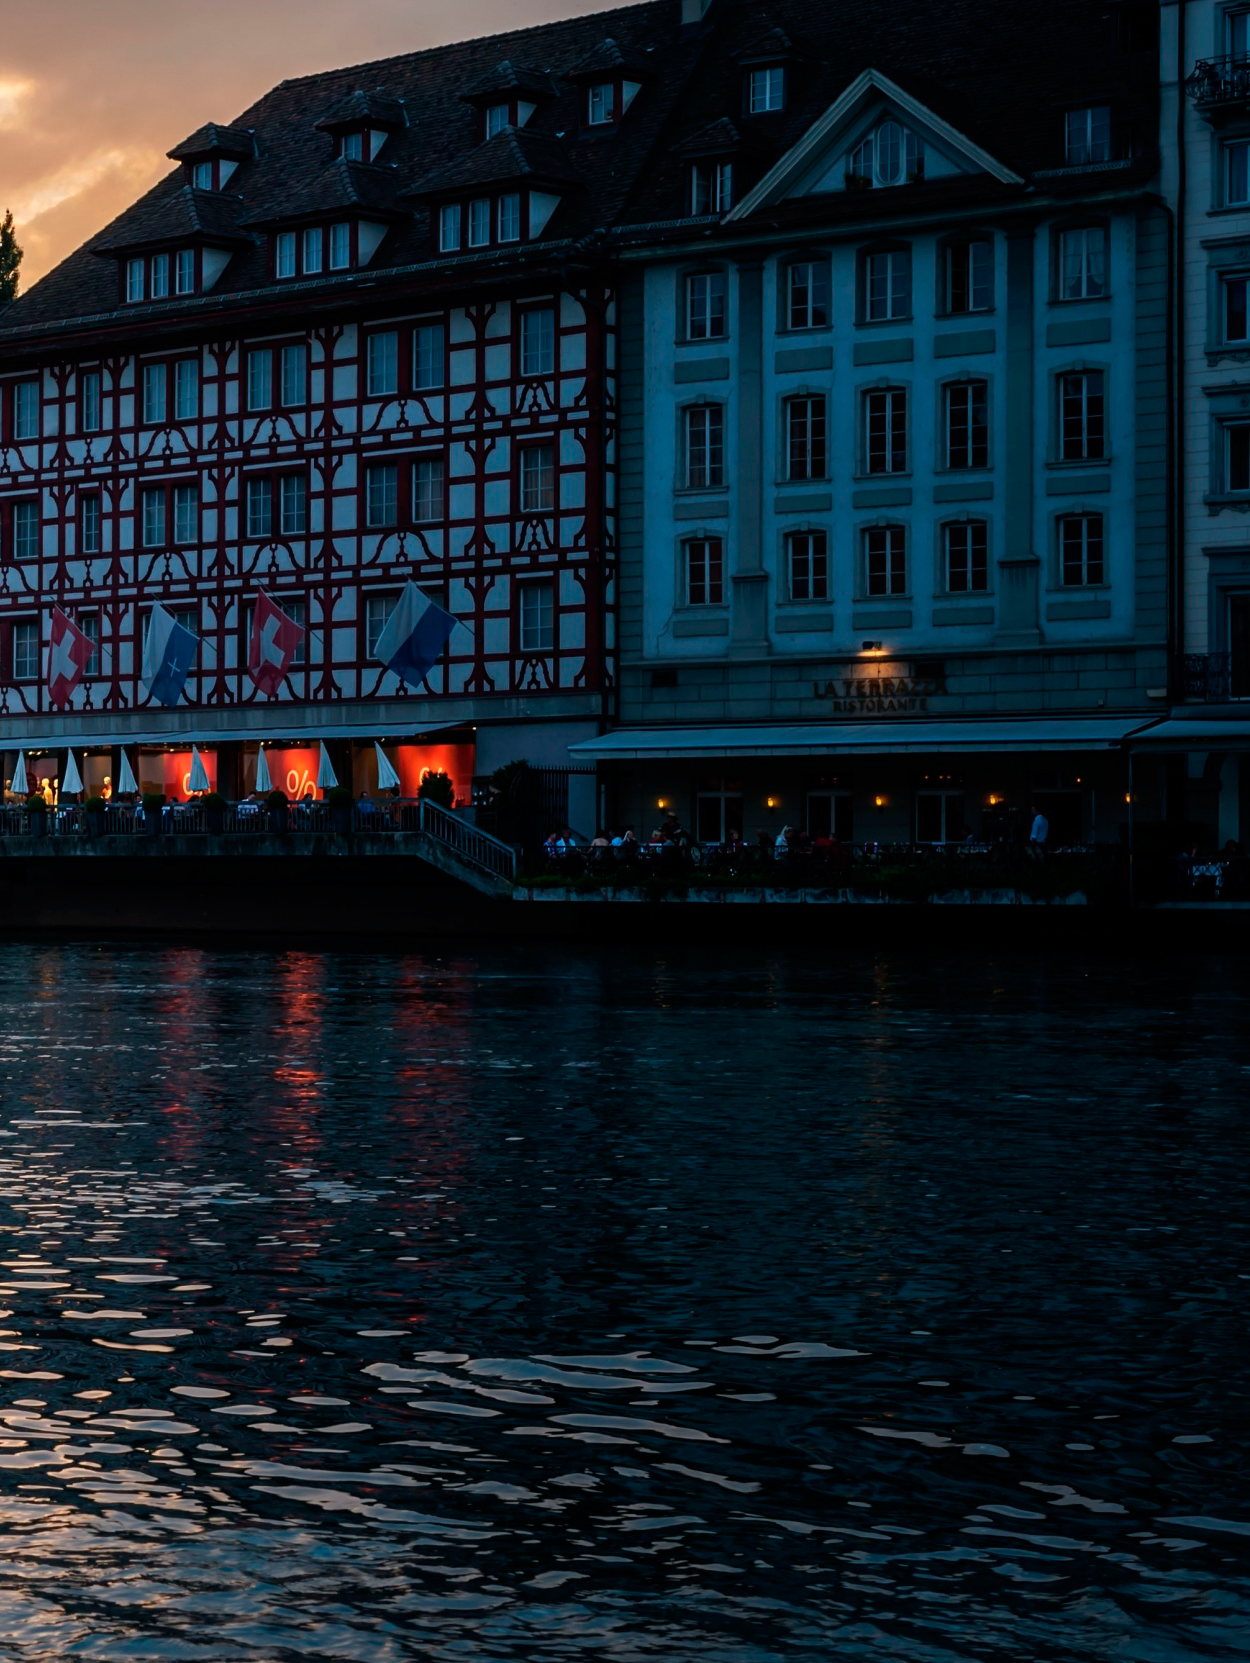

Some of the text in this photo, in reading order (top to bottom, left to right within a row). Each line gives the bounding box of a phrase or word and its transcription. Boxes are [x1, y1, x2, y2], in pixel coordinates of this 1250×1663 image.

[813, 677, 948, 698] LA TERRAZZA
[833, 698, 927, 713] RISTORANTE
[286, 769, 317, 800] %
